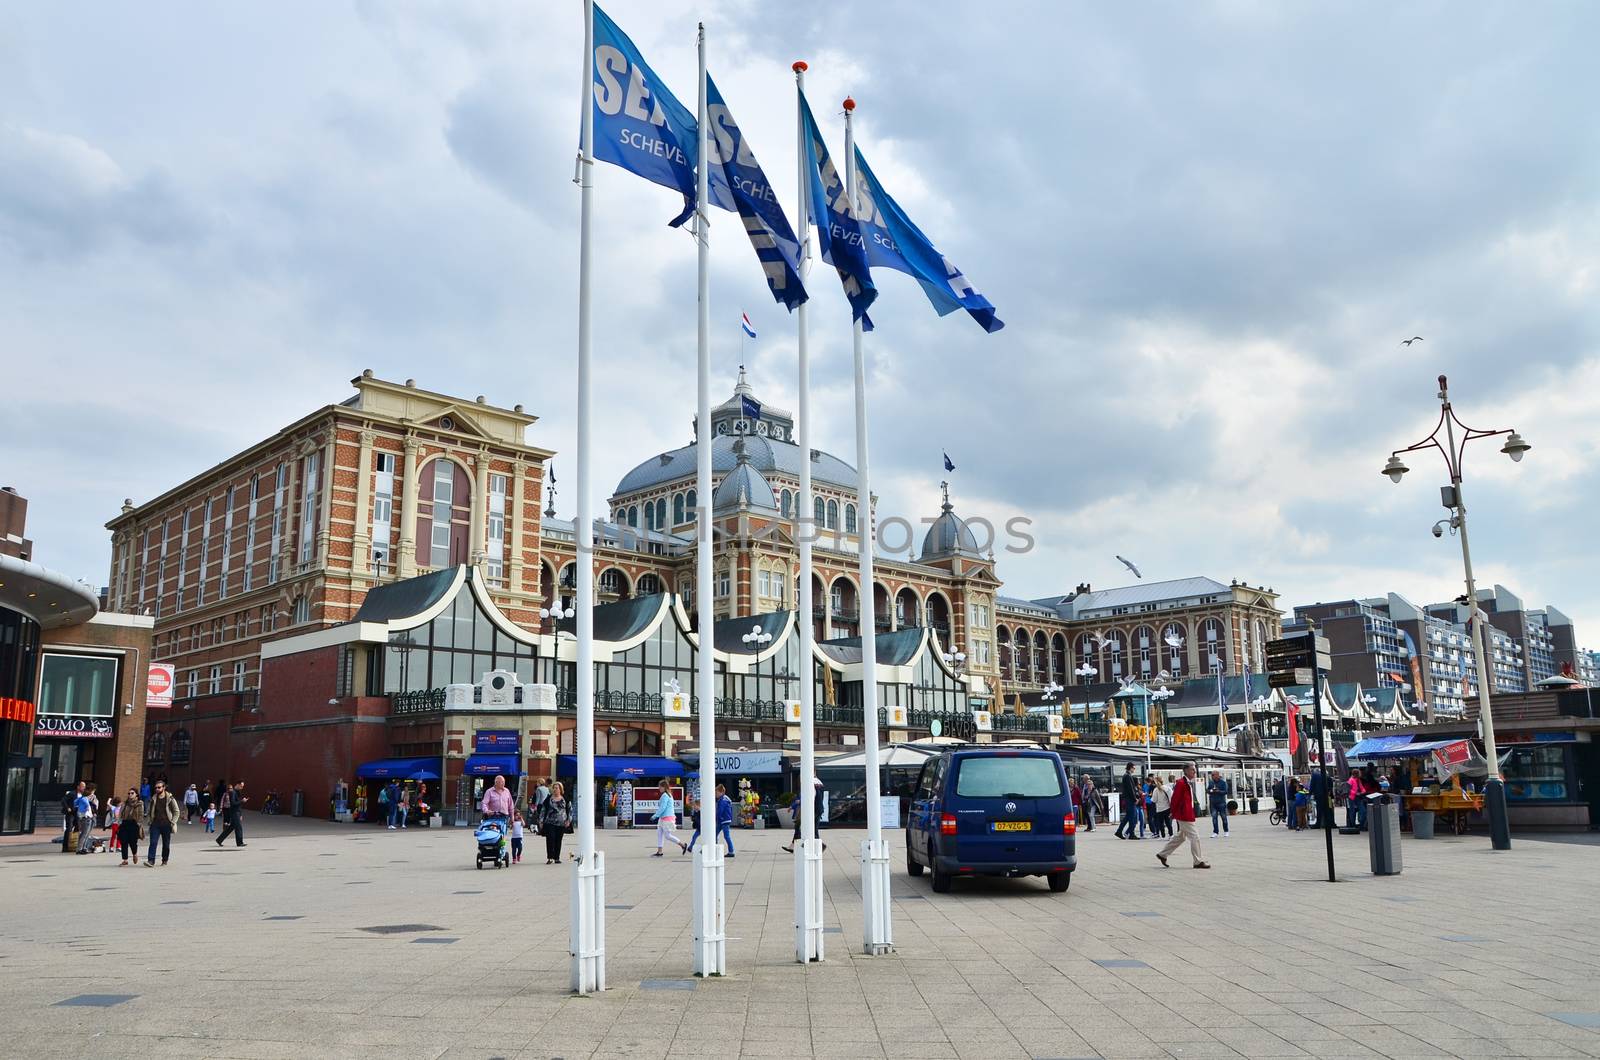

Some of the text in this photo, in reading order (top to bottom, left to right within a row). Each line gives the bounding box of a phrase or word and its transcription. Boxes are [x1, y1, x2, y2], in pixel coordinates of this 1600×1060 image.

[732, 175, 779, 204] SCHE
[37, 718, 85, 731] SUMO
[715, 756, 741, 770] BLVRD
